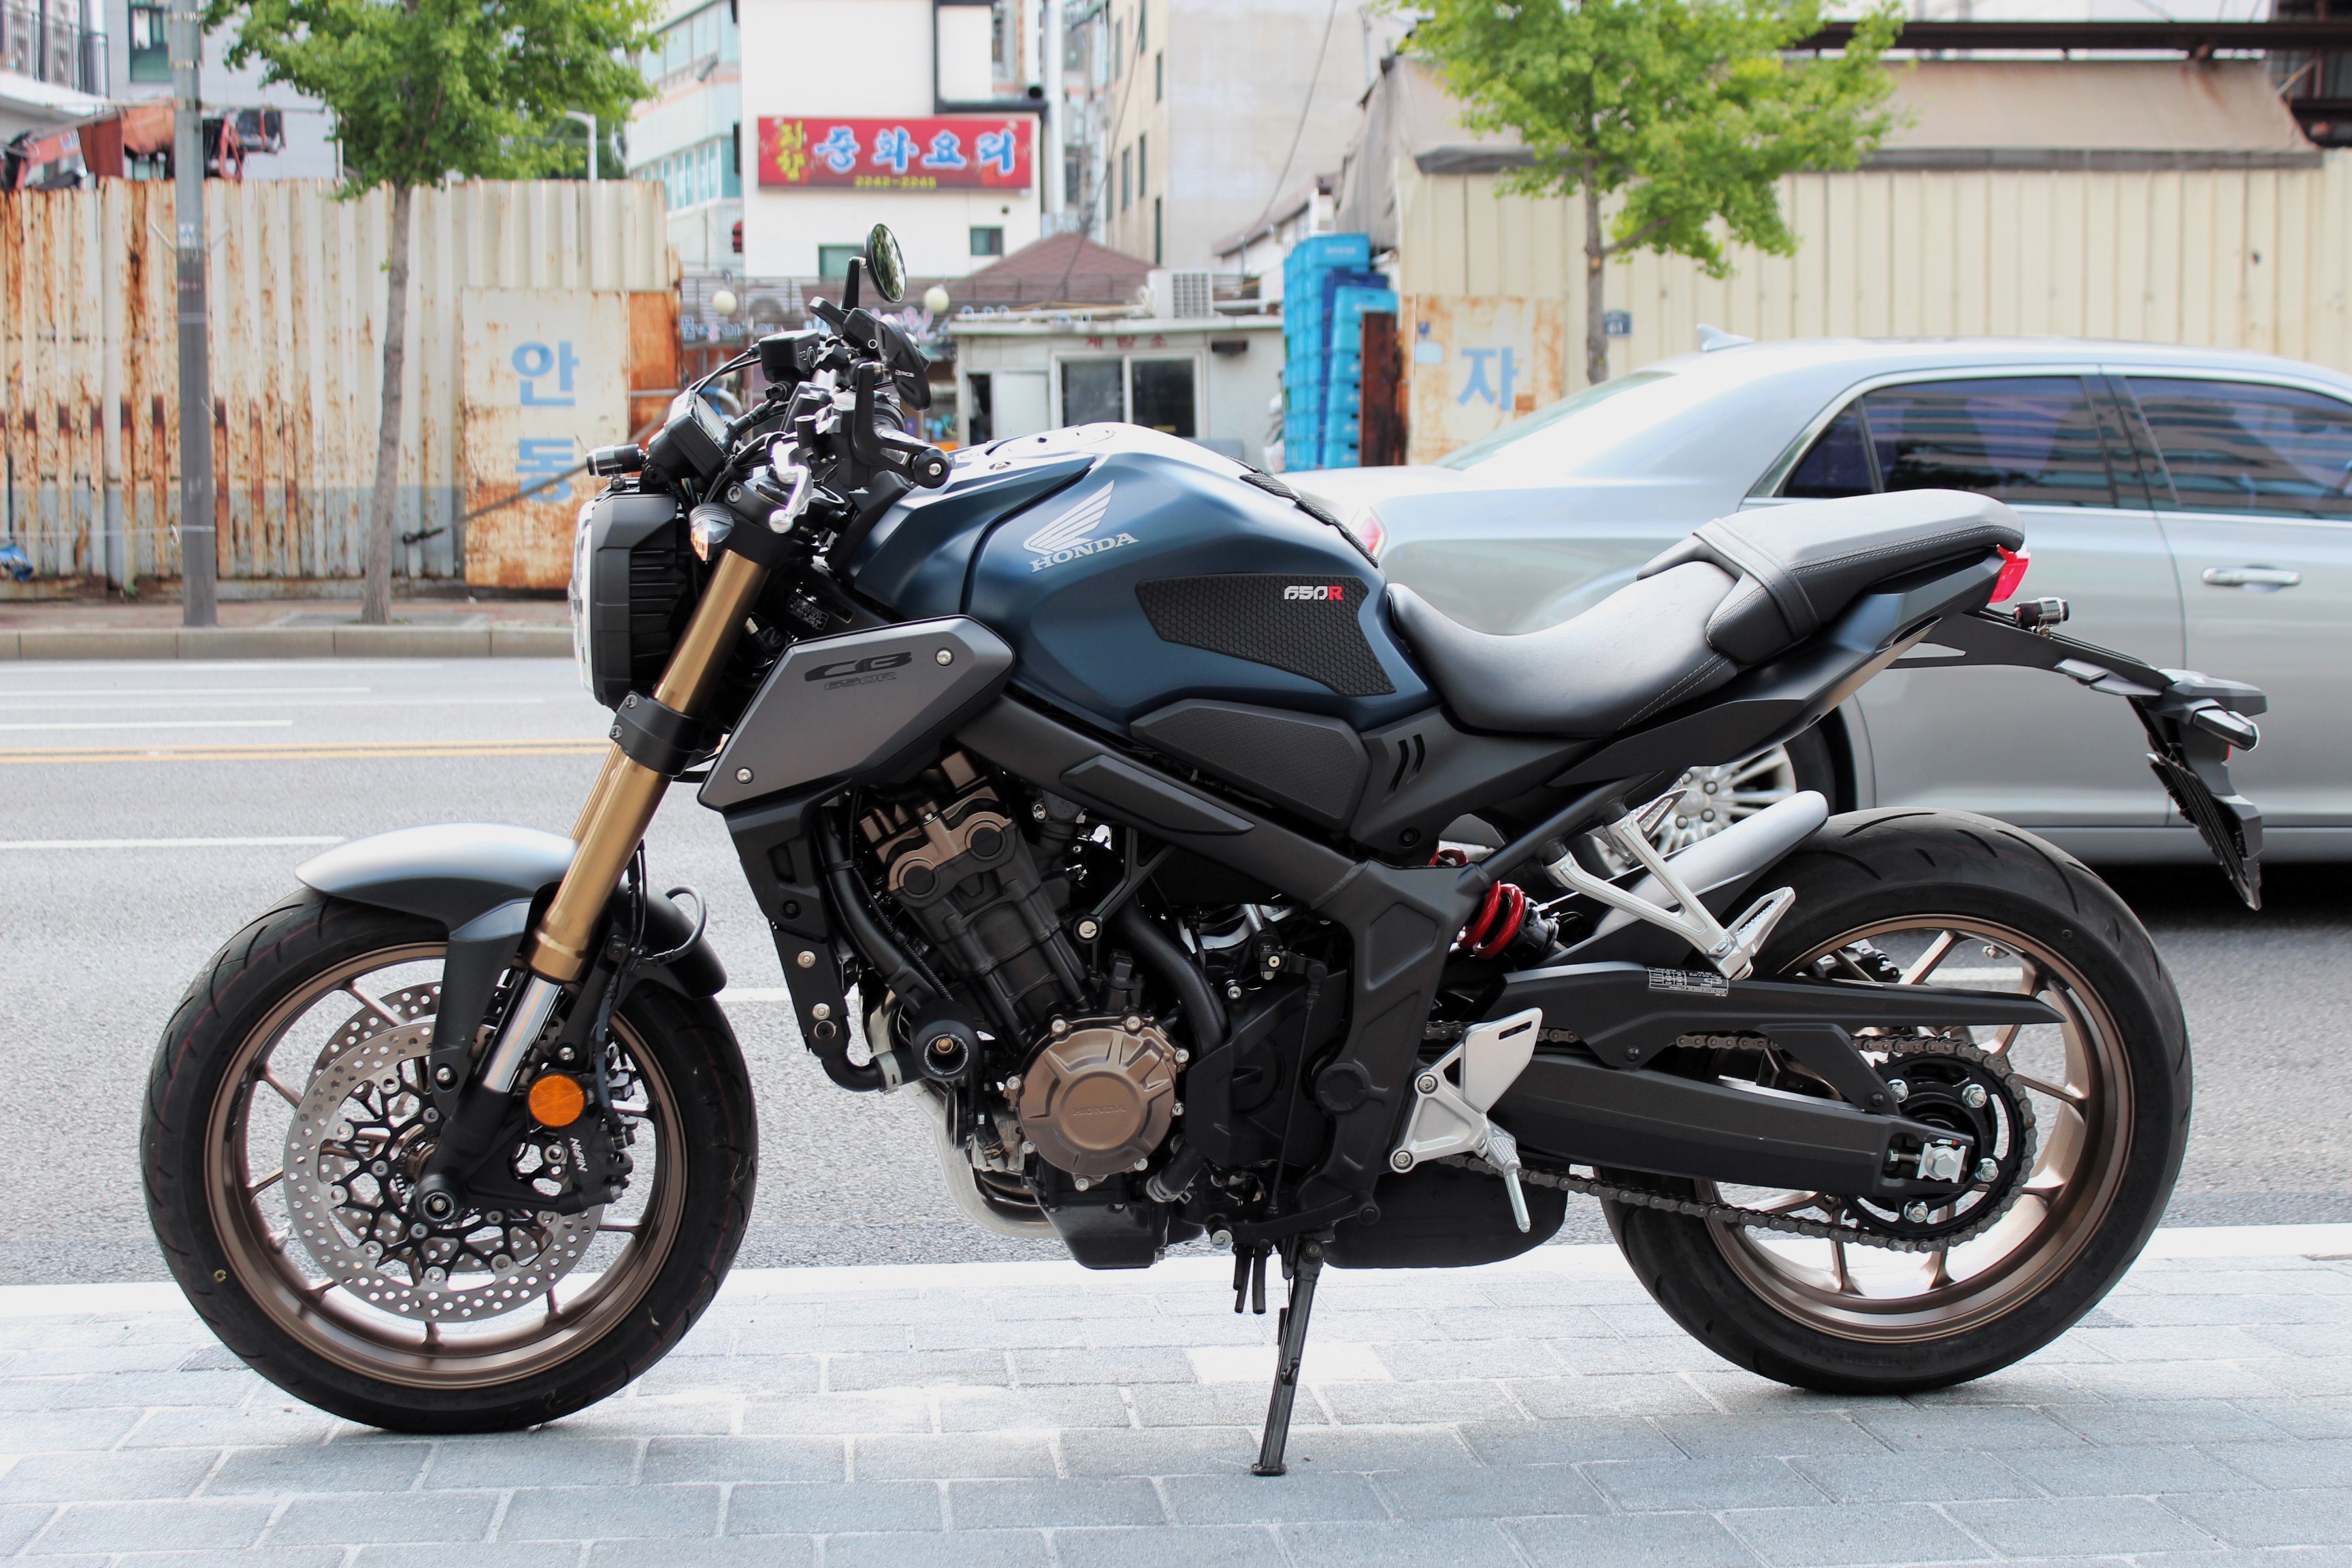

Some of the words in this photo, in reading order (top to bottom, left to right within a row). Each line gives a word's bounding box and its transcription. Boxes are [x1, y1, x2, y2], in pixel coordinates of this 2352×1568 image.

[813, 125, 1016, 176] 중화요리
[1030, 532, 1139, 573] HONDA
[1284, 585, 1344, 601] 650R
[804, 651, 912, 681] CB
[824, 671, 897, 690] 650R
